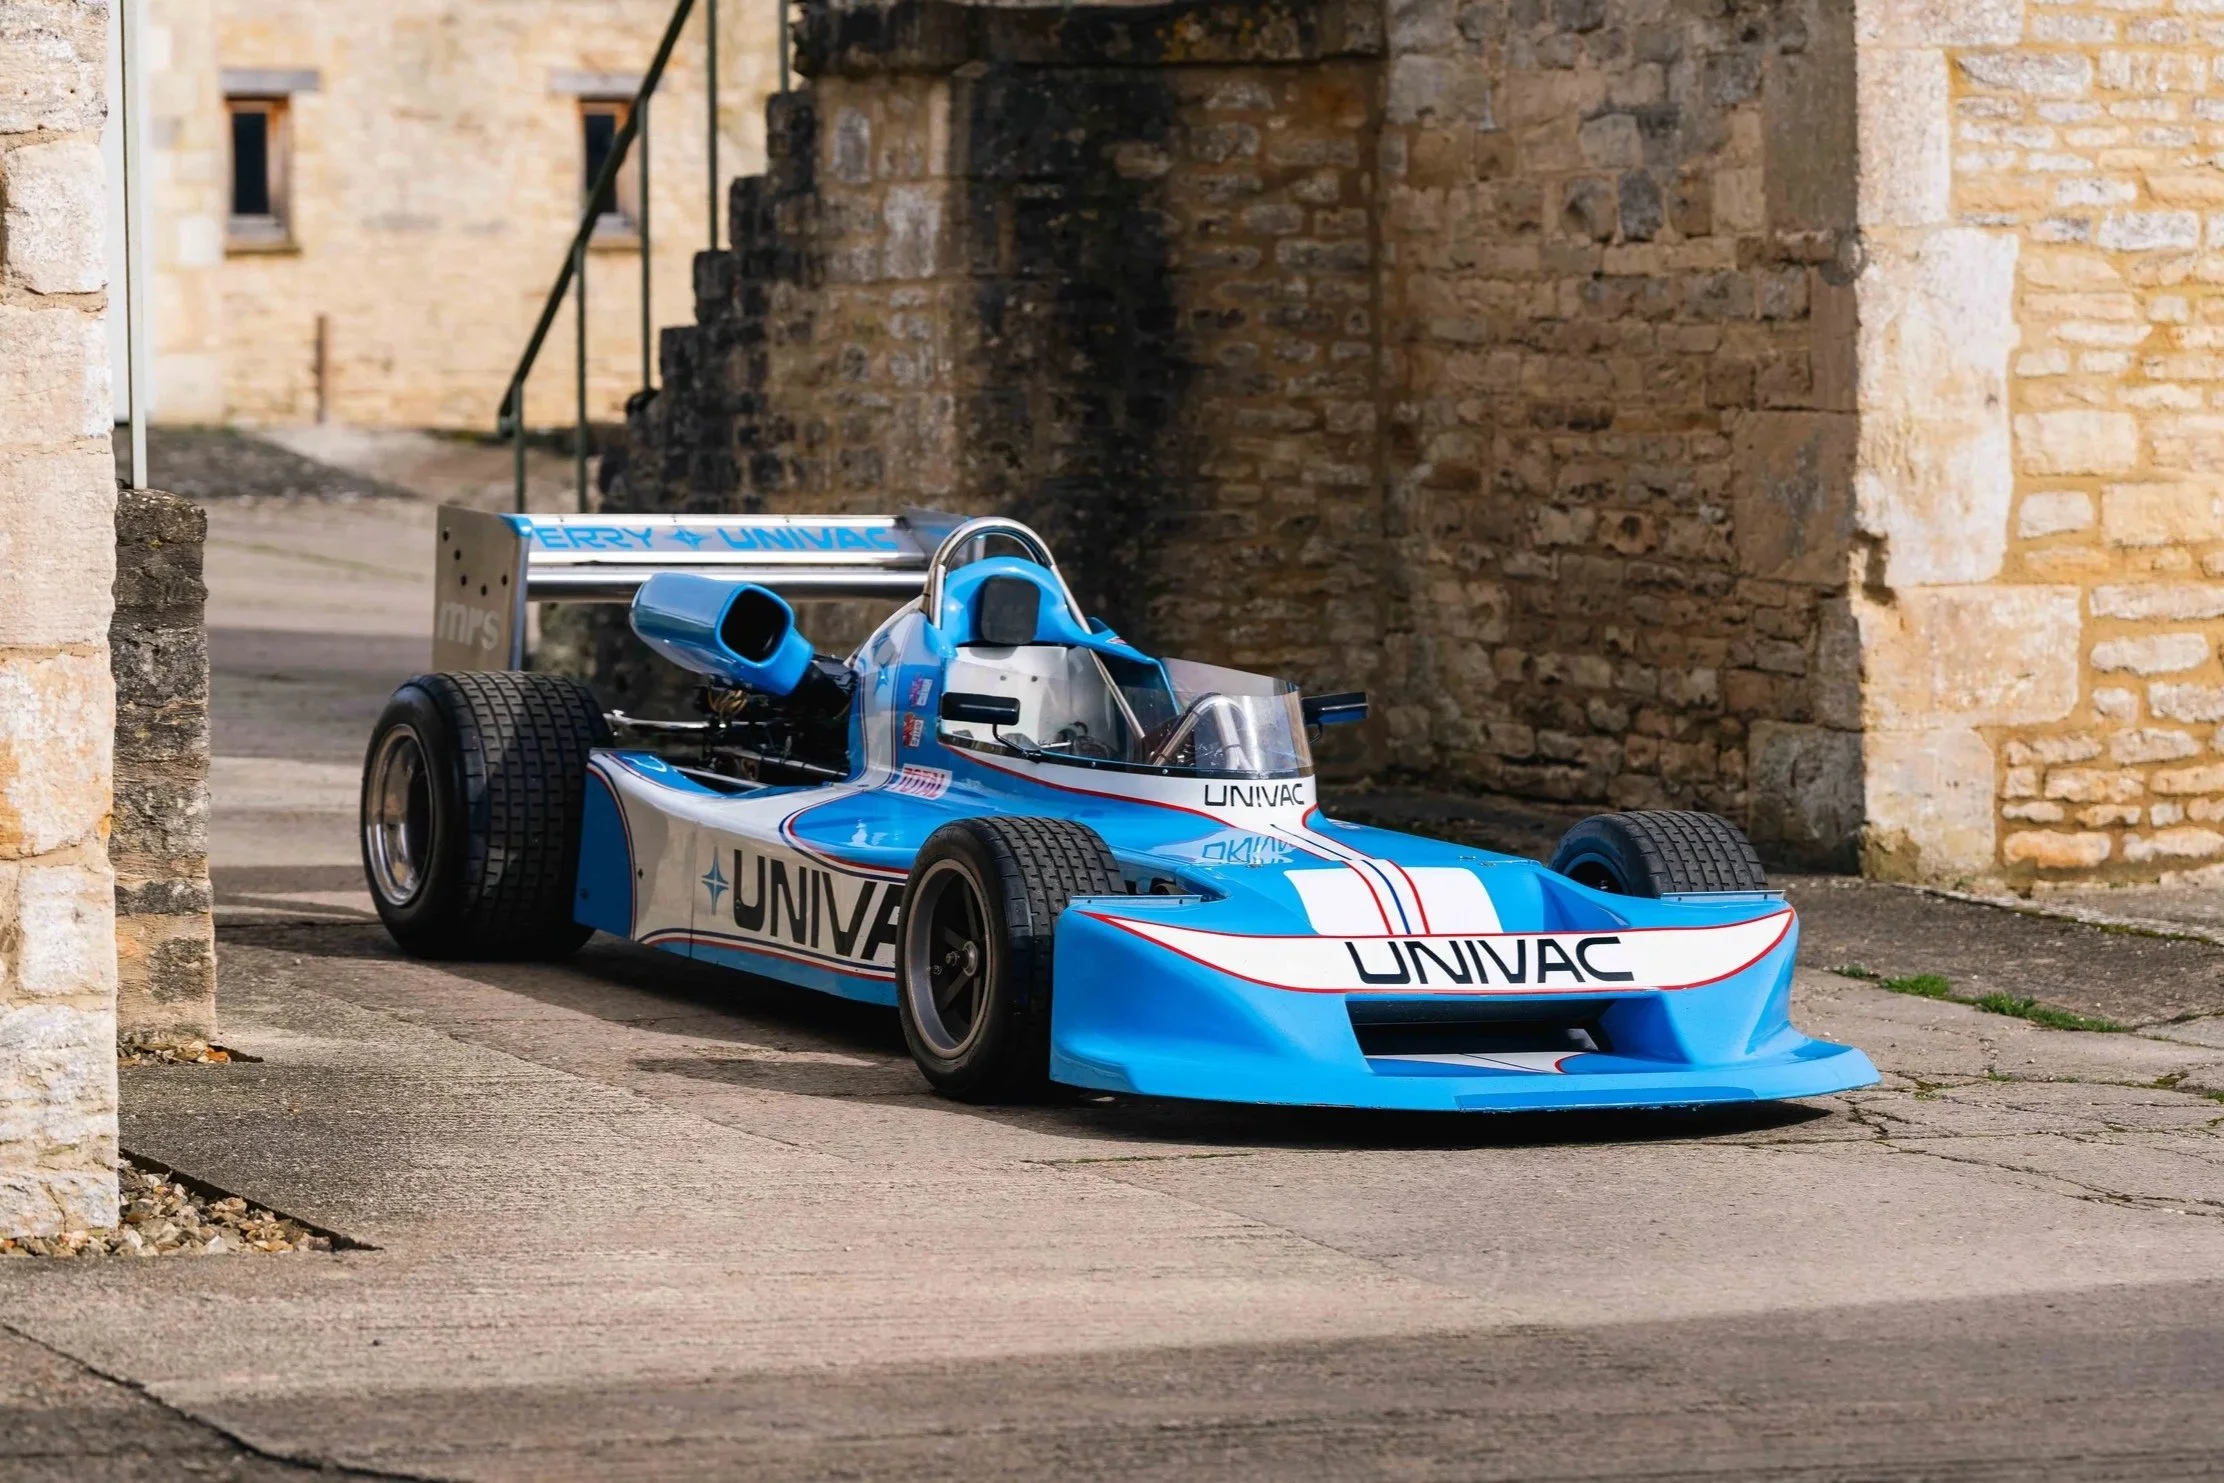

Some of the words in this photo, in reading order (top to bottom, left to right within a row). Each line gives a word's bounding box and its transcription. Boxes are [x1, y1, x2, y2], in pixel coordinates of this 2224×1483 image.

[718, 526, 899, 550] UNIVAC
[436, 601, 501, 650] mrs
[1204, 783, 1305, 807] UNIVAC
[1345, 936, 1634, 985] UNIVAC
